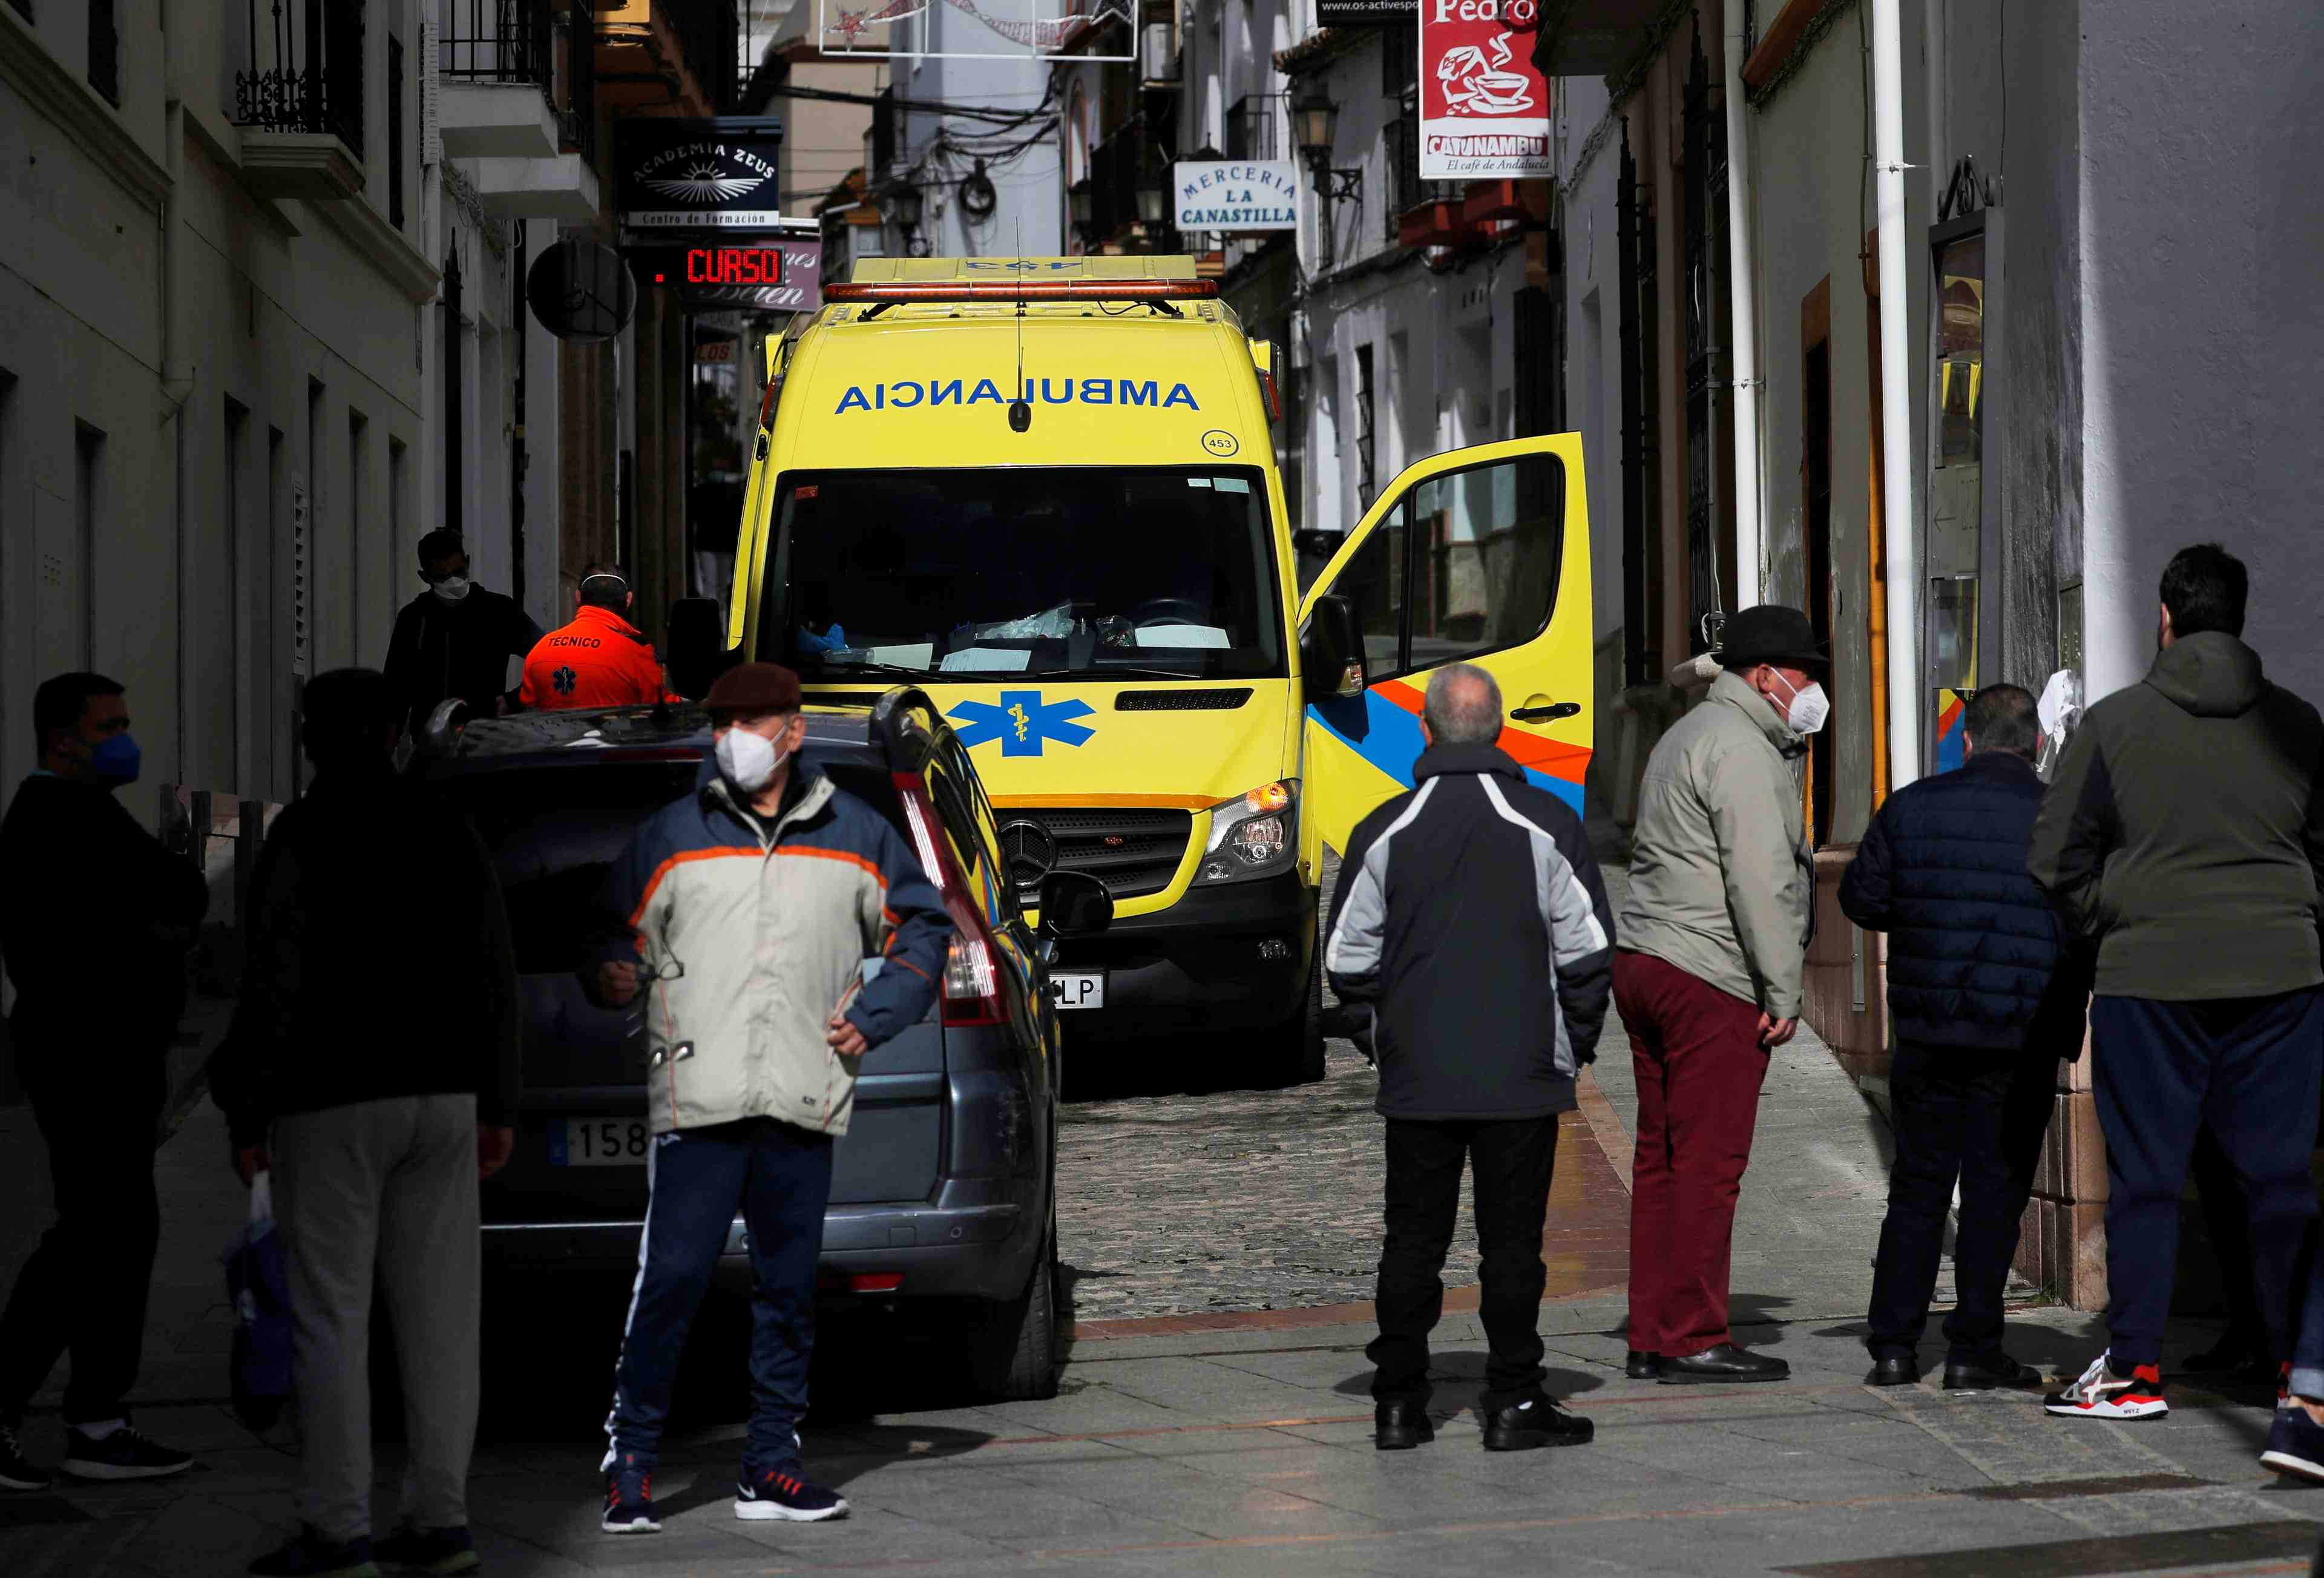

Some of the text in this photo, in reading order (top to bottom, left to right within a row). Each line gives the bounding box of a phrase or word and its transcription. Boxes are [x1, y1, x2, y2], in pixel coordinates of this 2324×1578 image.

[633, 142, 775, 183] ACADEMIA ZEUS
[1447, 158, 1549, 173] El café de Andalucía
[1183, 166, 1296, 200] MERCERIA
[1226, 189, 1253, 203] LA
[643, 213, 766, 225] Centro de Formación
[1181, 208, 1296, 223] CANASTILLA
[687, 248, 780, 283] CURSO
[1209, 439, 1232, 448] 453
[547, 636, 601, 649] TECNICO
[1052, 979, 1094, 1005] LP
